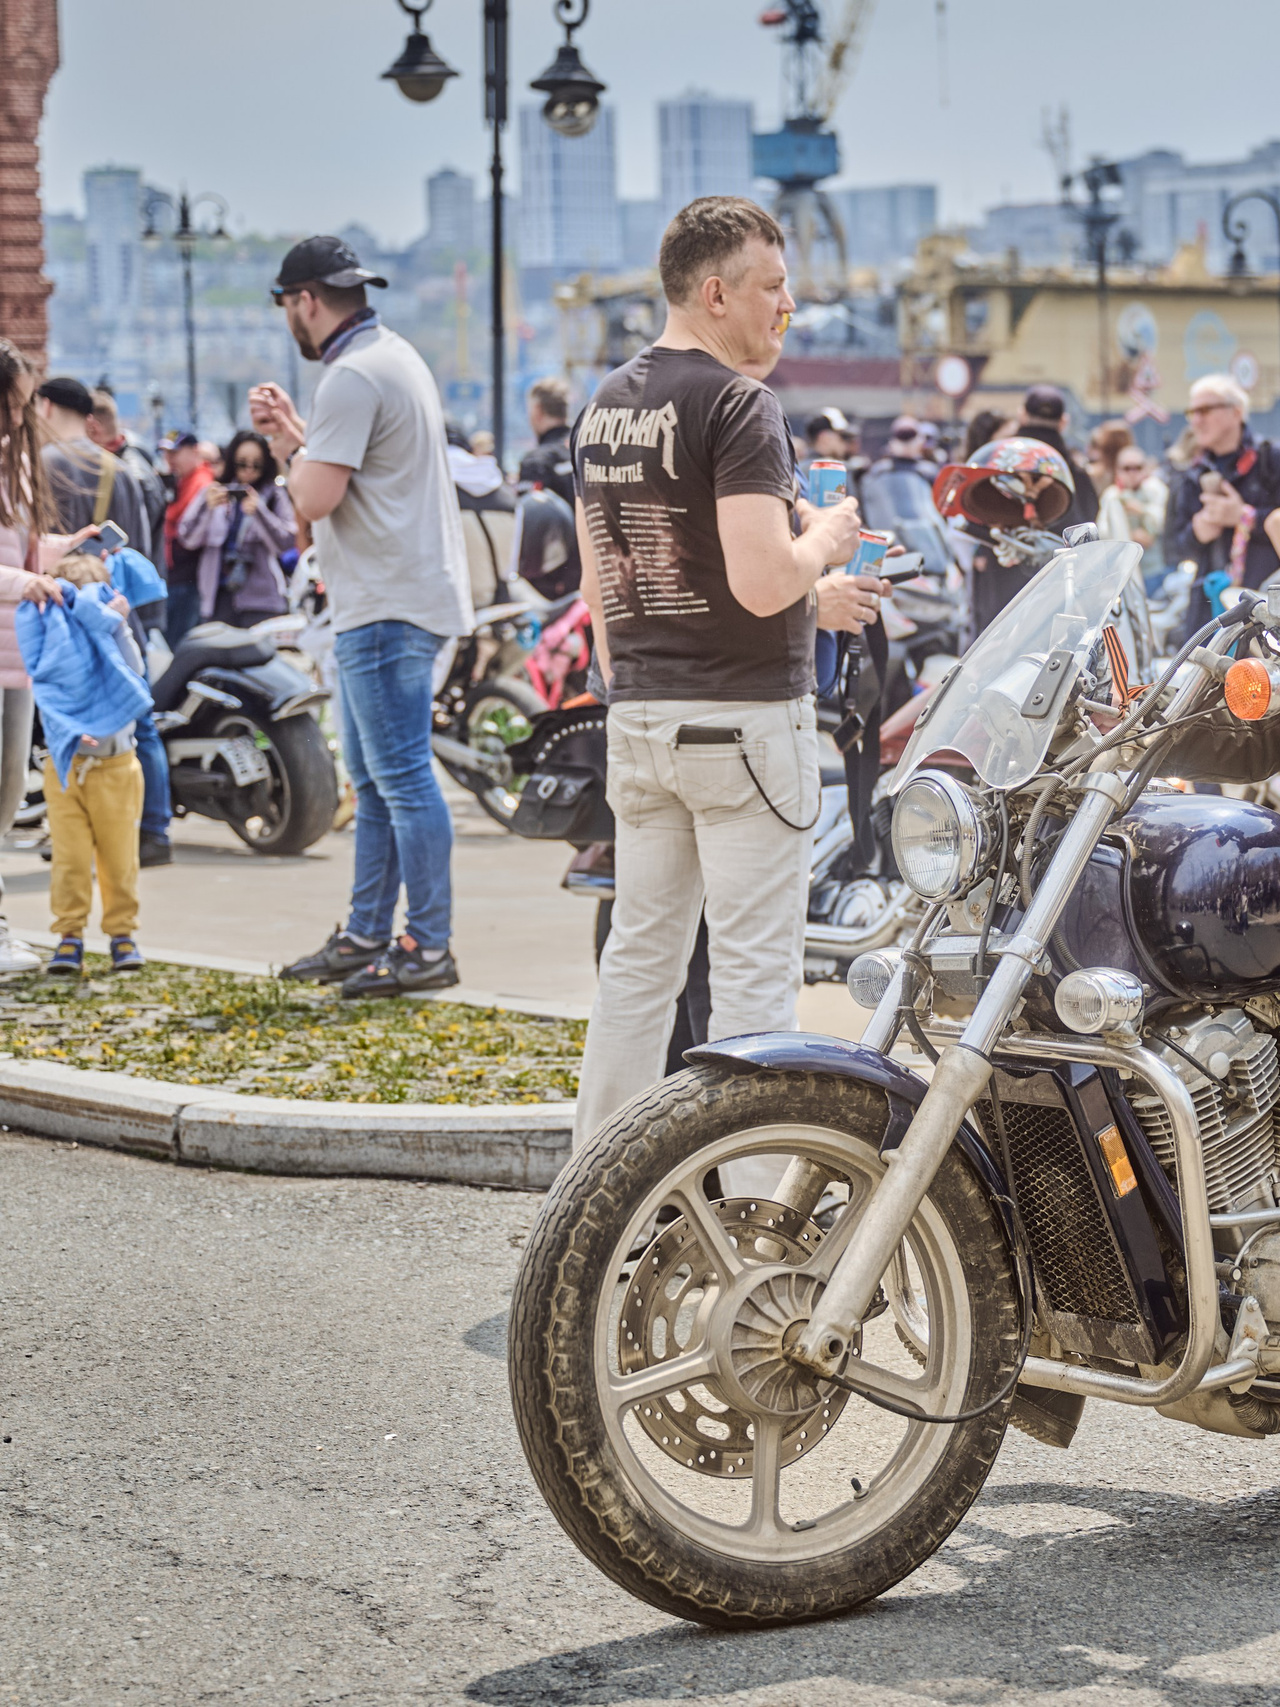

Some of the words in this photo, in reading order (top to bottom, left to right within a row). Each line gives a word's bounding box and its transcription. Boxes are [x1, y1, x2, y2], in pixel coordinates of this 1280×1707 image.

[579, 400, 680, 480] MANOWAR
[584, 457, 608, 483] FINAL
[608, 461, 644, 483] BATTLE
